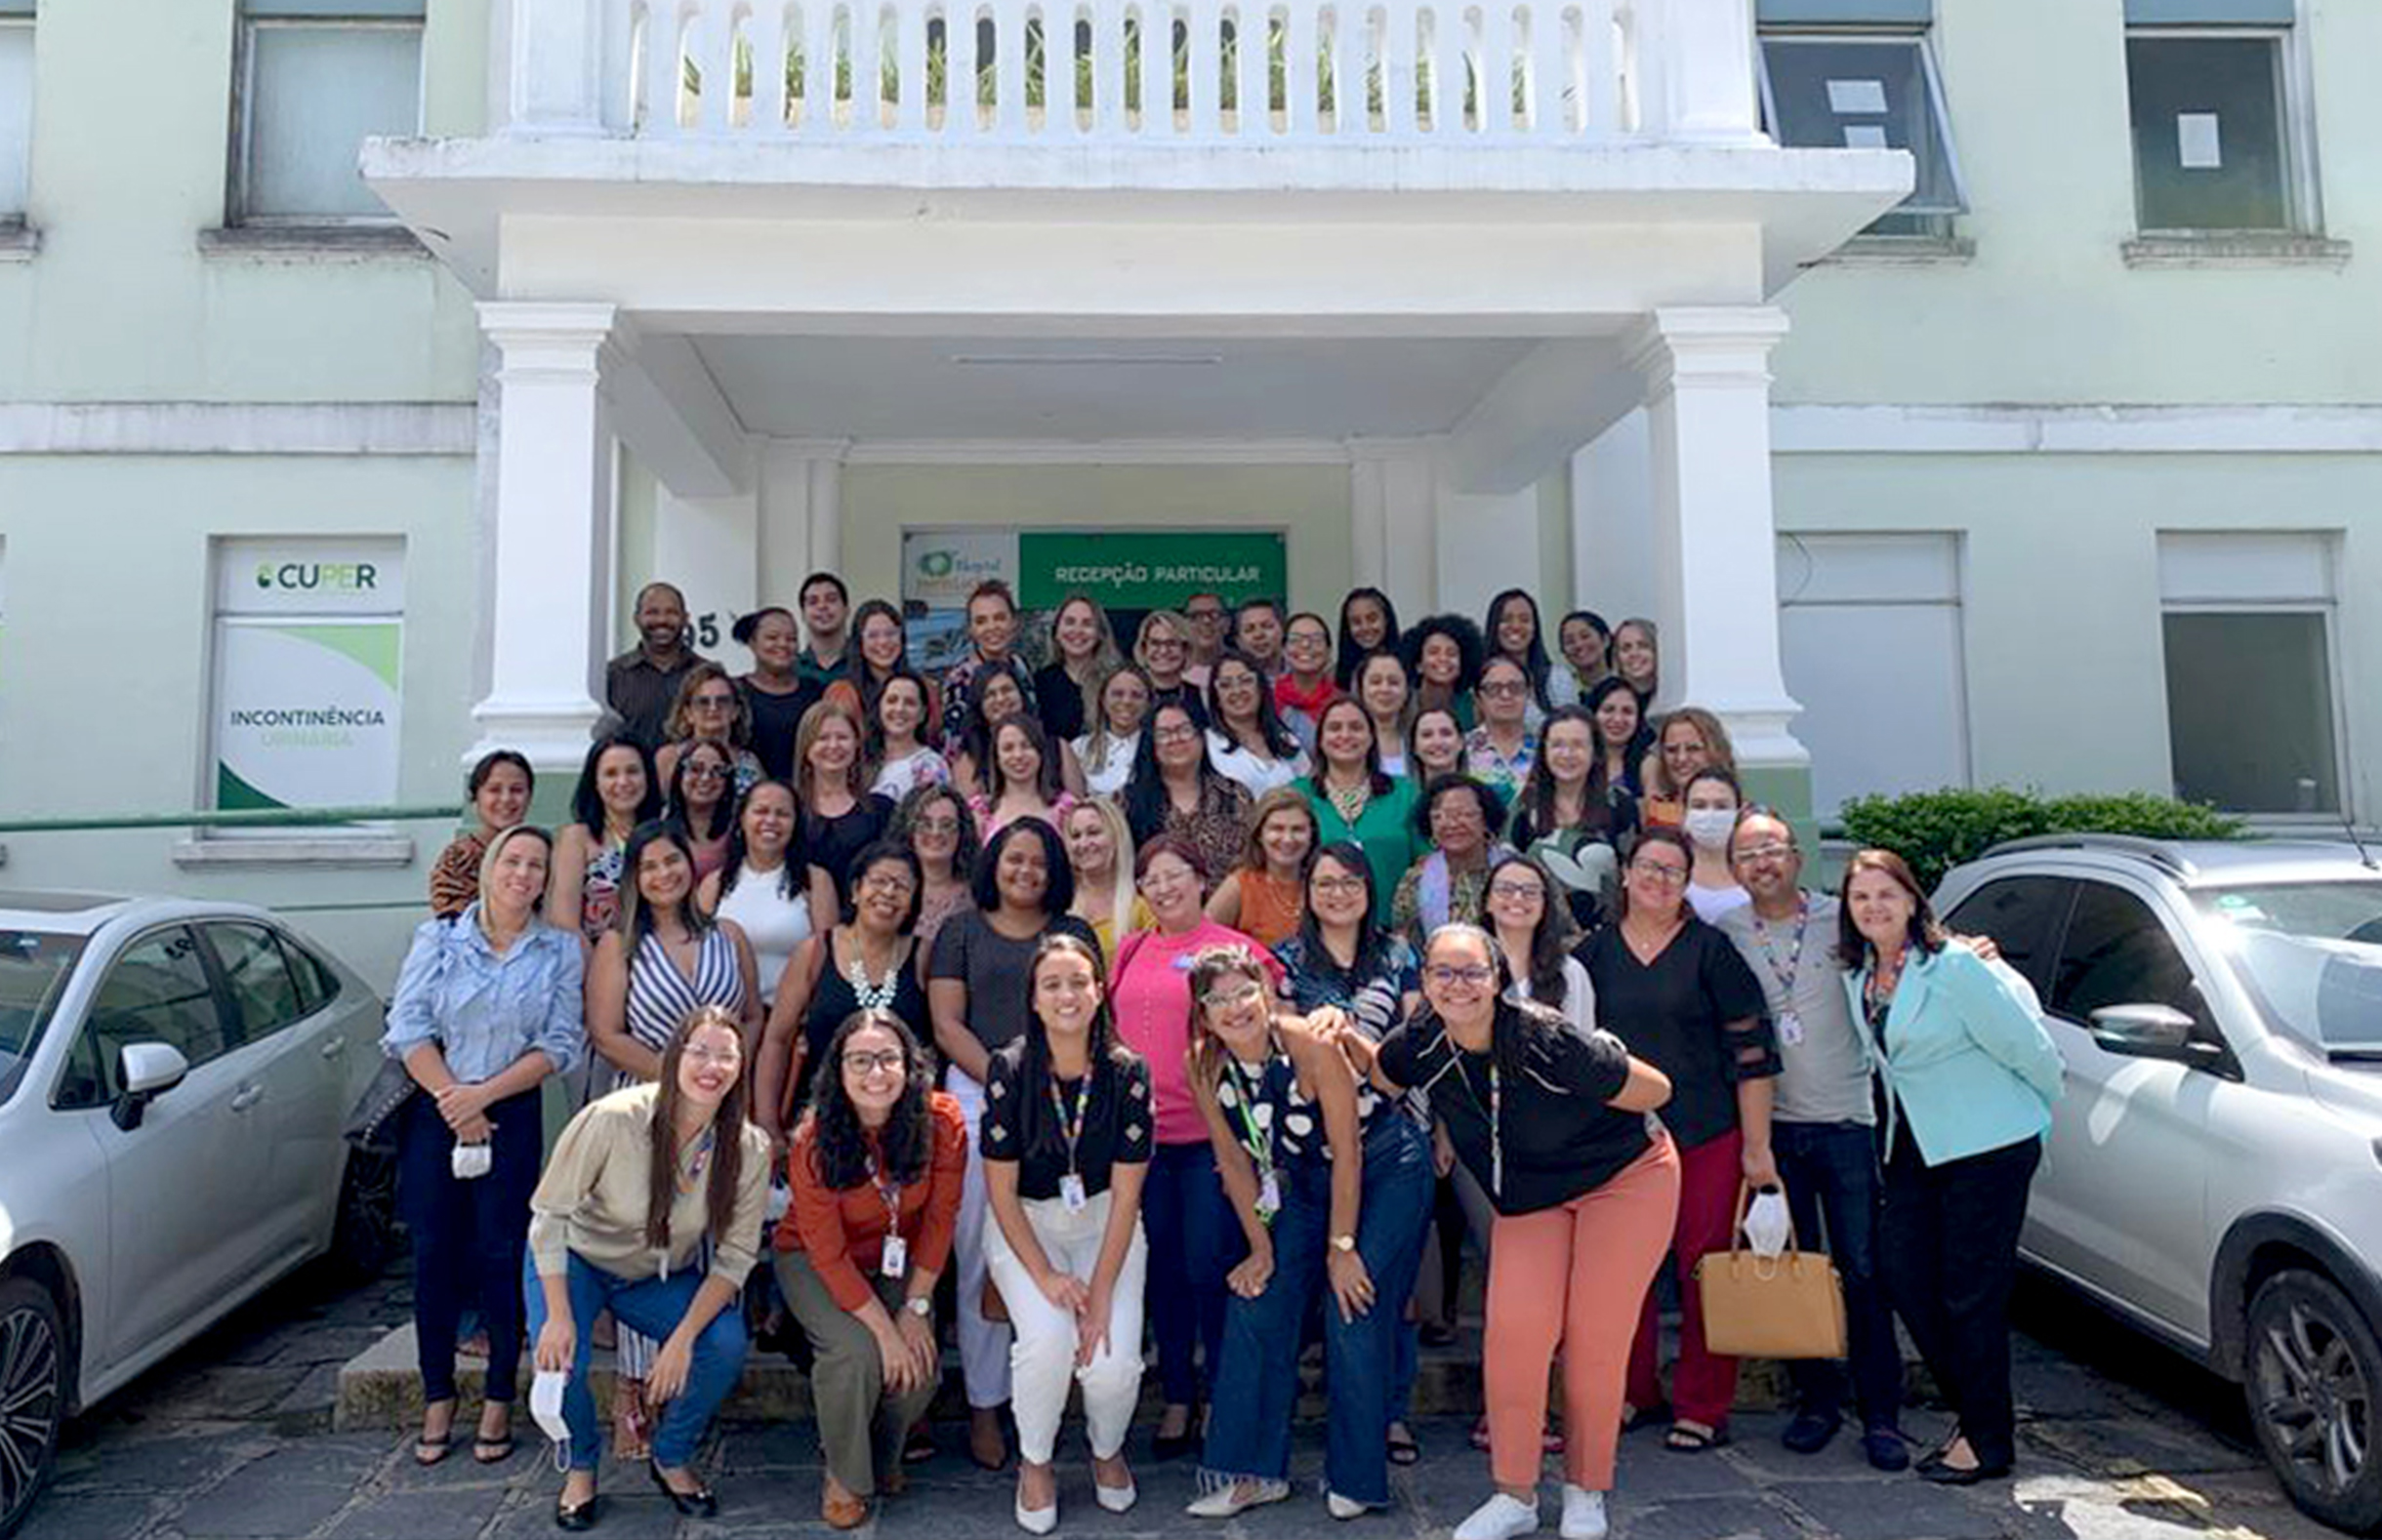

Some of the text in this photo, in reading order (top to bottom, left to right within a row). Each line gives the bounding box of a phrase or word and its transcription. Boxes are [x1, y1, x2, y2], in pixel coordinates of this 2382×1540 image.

[278, 563, 377, 588] CUPER
[1055, 563, 1259, 588] RECEPÇÃO PARTICULAR
[230, 706, 385, 725] INCONTINÊNCIA
